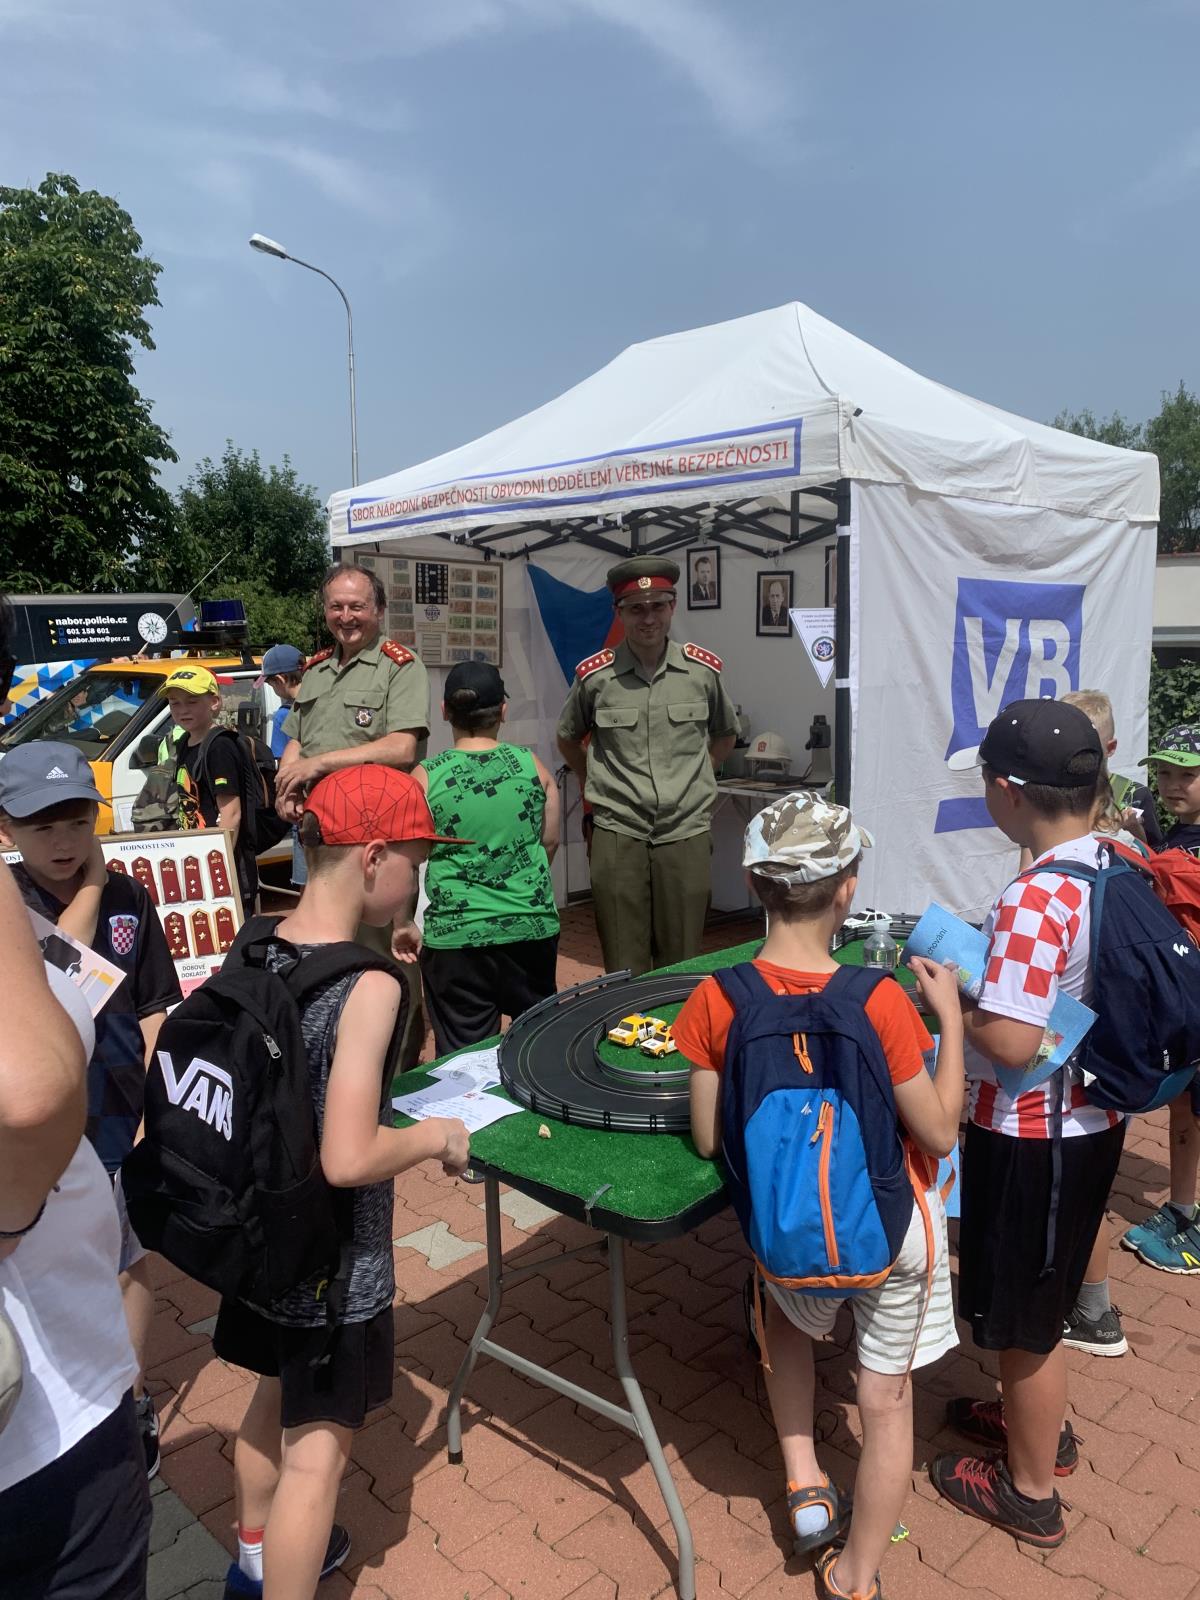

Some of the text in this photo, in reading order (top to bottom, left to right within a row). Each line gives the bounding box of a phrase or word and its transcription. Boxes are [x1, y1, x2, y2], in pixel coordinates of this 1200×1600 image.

[352, 504, 376, 522] SBOR
[421, 486, 488, 510] BEZPEČNOSTI
[491, 474, 545, 500] OBVODNÍ
[548, 465, 612, 493] ODDĚLENÍ
[615, 454, 674, 482] VEŘEJNÉ
[678, 440, 789, 474] BEZPEČNOSTI
[55, 616, 128, 626] nabor.policie.cz
[68, 635, 131, 645] nabor.brno@pcr.cz
[963, 616, 1072, 728] VB
[120, 842, 160, 852] HODNOSTI
[182, 963, 206, 971] DOBOVÉ
[181, 970, 207, 979] DOKLADY
[157, 1051, 233, 1141] VANS
